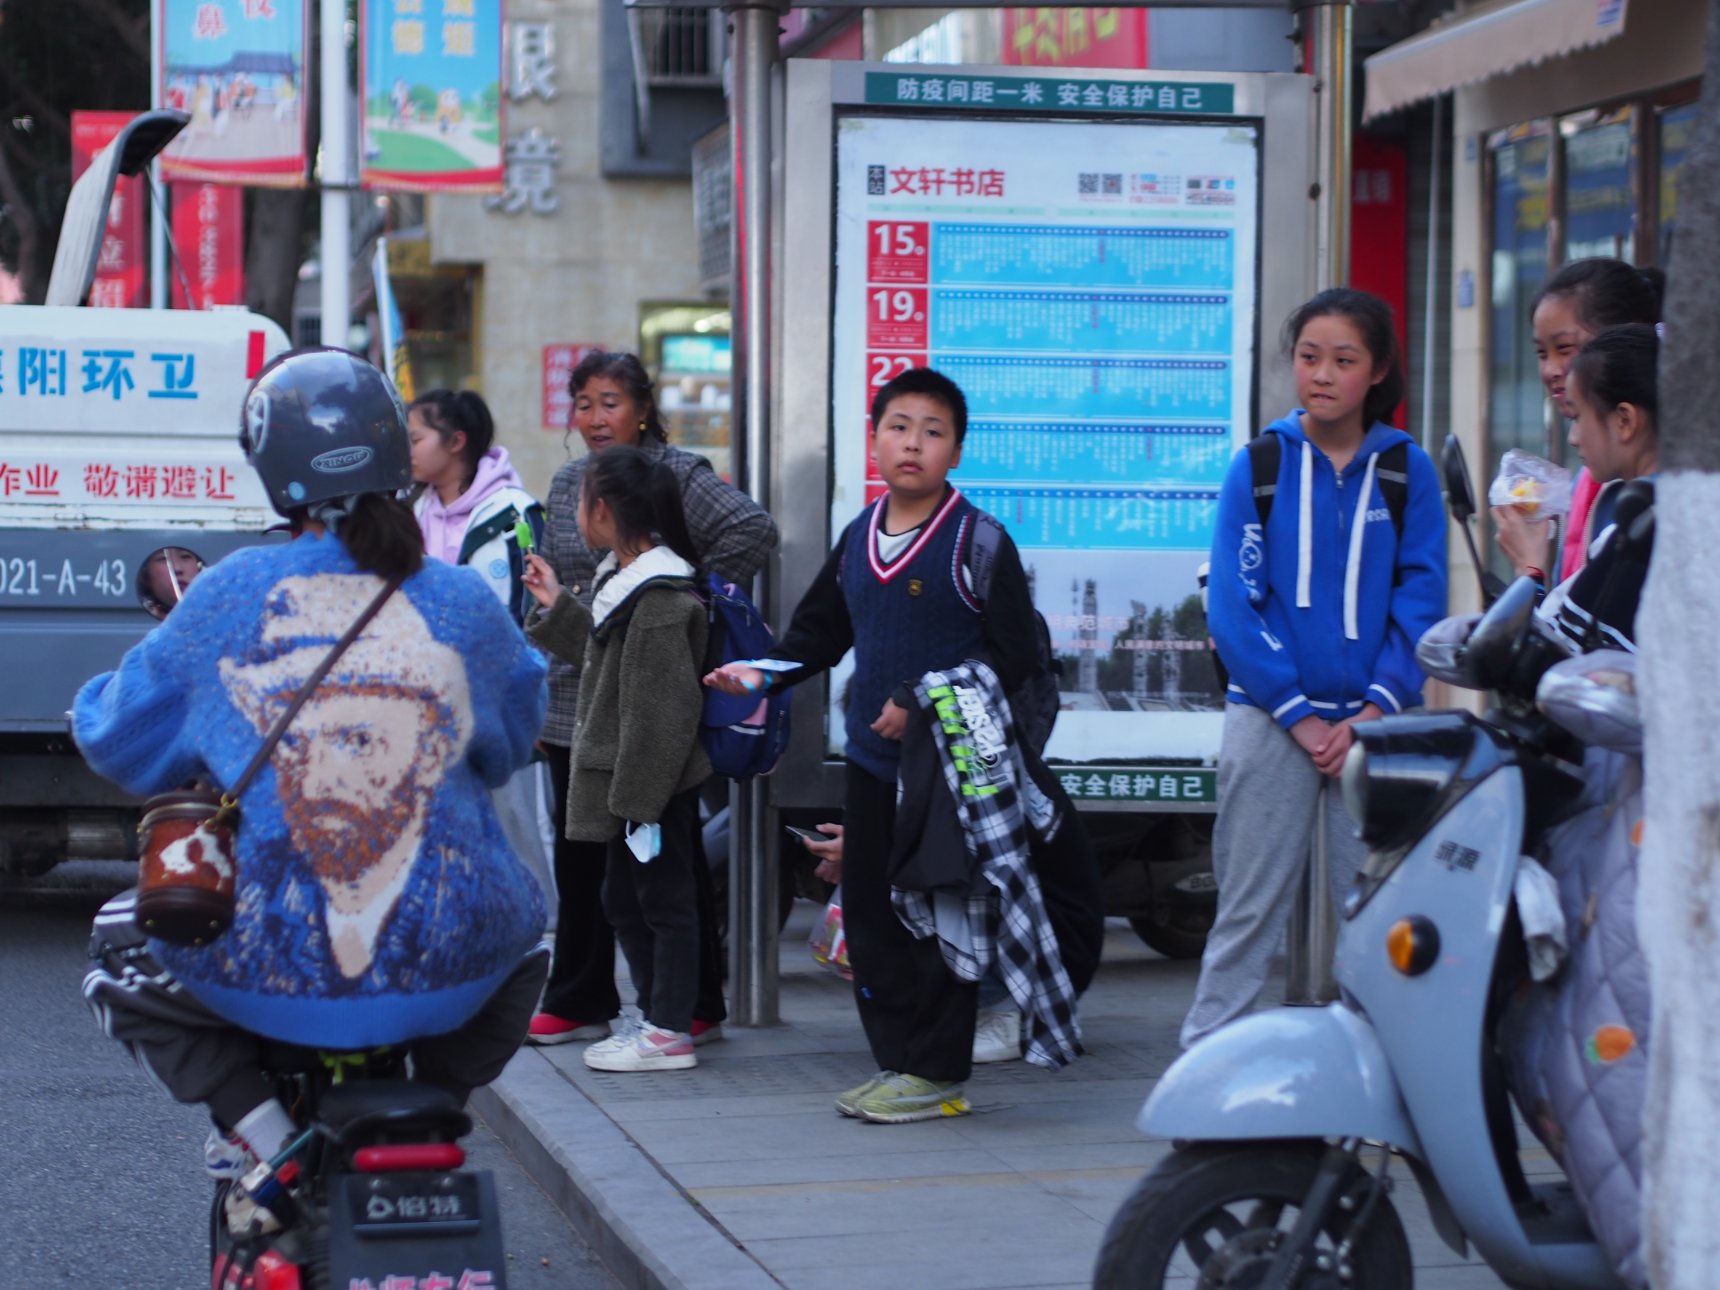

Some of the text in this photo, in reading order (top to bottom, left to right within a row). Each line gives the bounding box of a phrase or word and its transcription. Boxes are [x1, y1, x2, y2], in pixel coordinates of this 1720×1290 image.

[896, 78, 1203, 110] 防疫间距一米 安全保护自己
[889, 166, 1005, 197] 文轩书店
[0, 347, 198, 400] 阳环卫
[83, 463, 236, 500] 敬请避让
[1059, 772, 1204, 798] 安全保护自己
